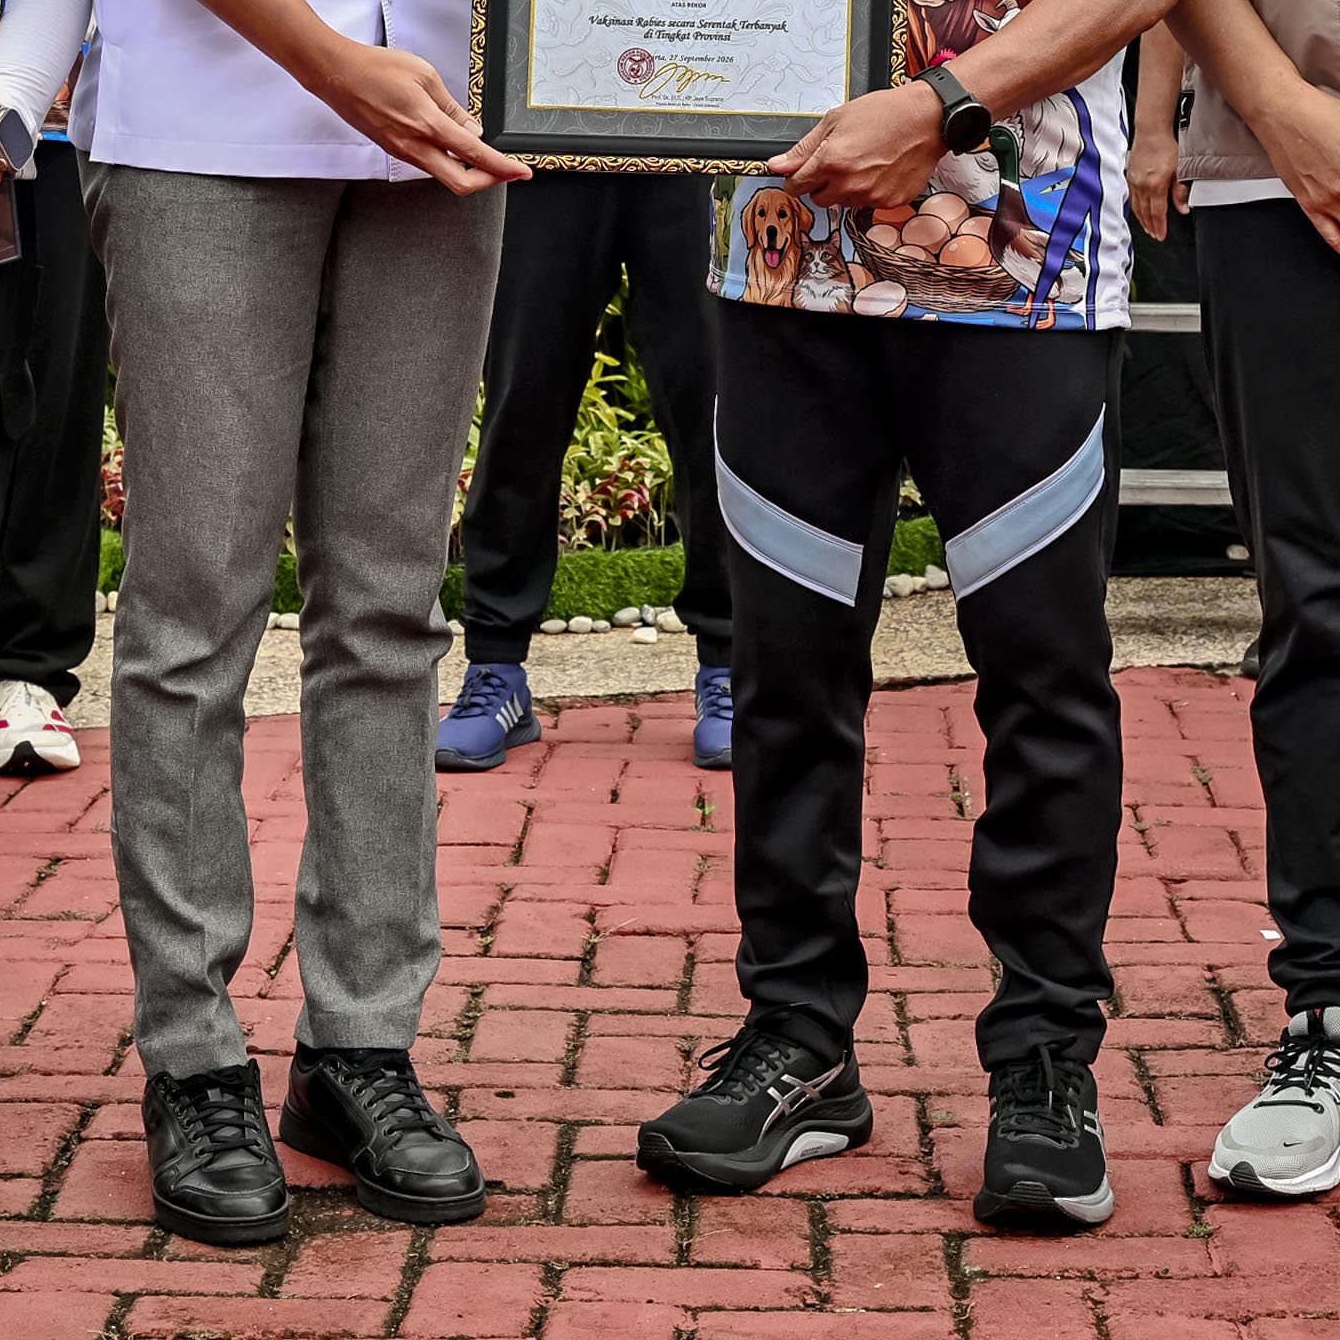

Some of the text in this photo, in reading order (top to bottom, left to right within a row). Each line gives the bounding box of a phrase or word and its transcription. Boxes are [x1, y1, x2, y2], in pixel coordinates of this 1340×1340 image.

[588, 14, 789, 33] Vaksinasi Rabies secara Serentak Terbanyak
[643, 29, 733, 42] di Tingkat Provinsi
[680, 54, 717, 64] September
